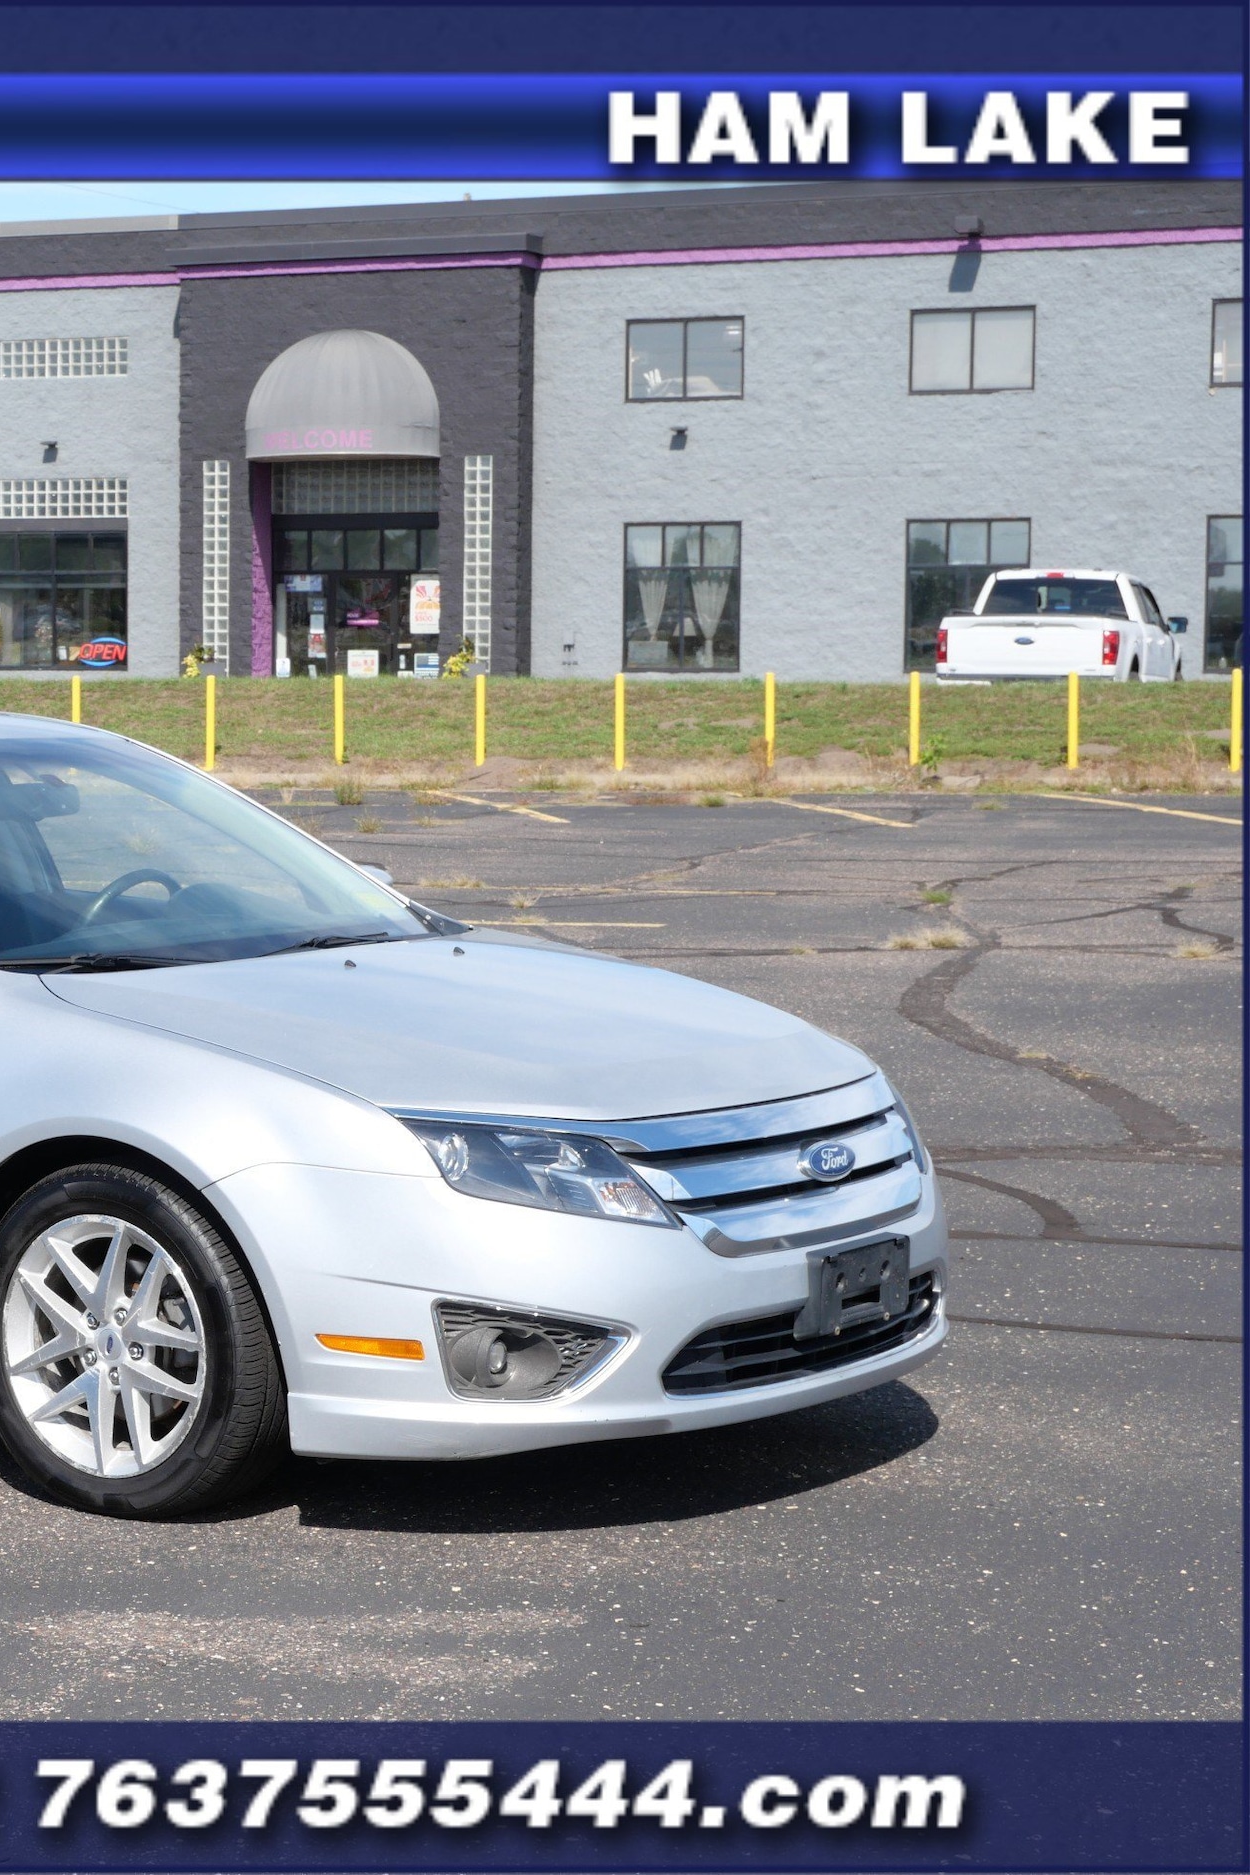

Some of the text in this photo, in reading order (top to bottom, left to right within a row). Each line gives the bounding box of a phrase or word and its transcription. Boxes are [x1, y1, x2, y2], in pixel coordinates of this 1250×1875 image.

[262, 428, 374, 449] WELCOME
[79, 643, 127, 661] OPEN
[820, 1146, 849, 1171] Ford
